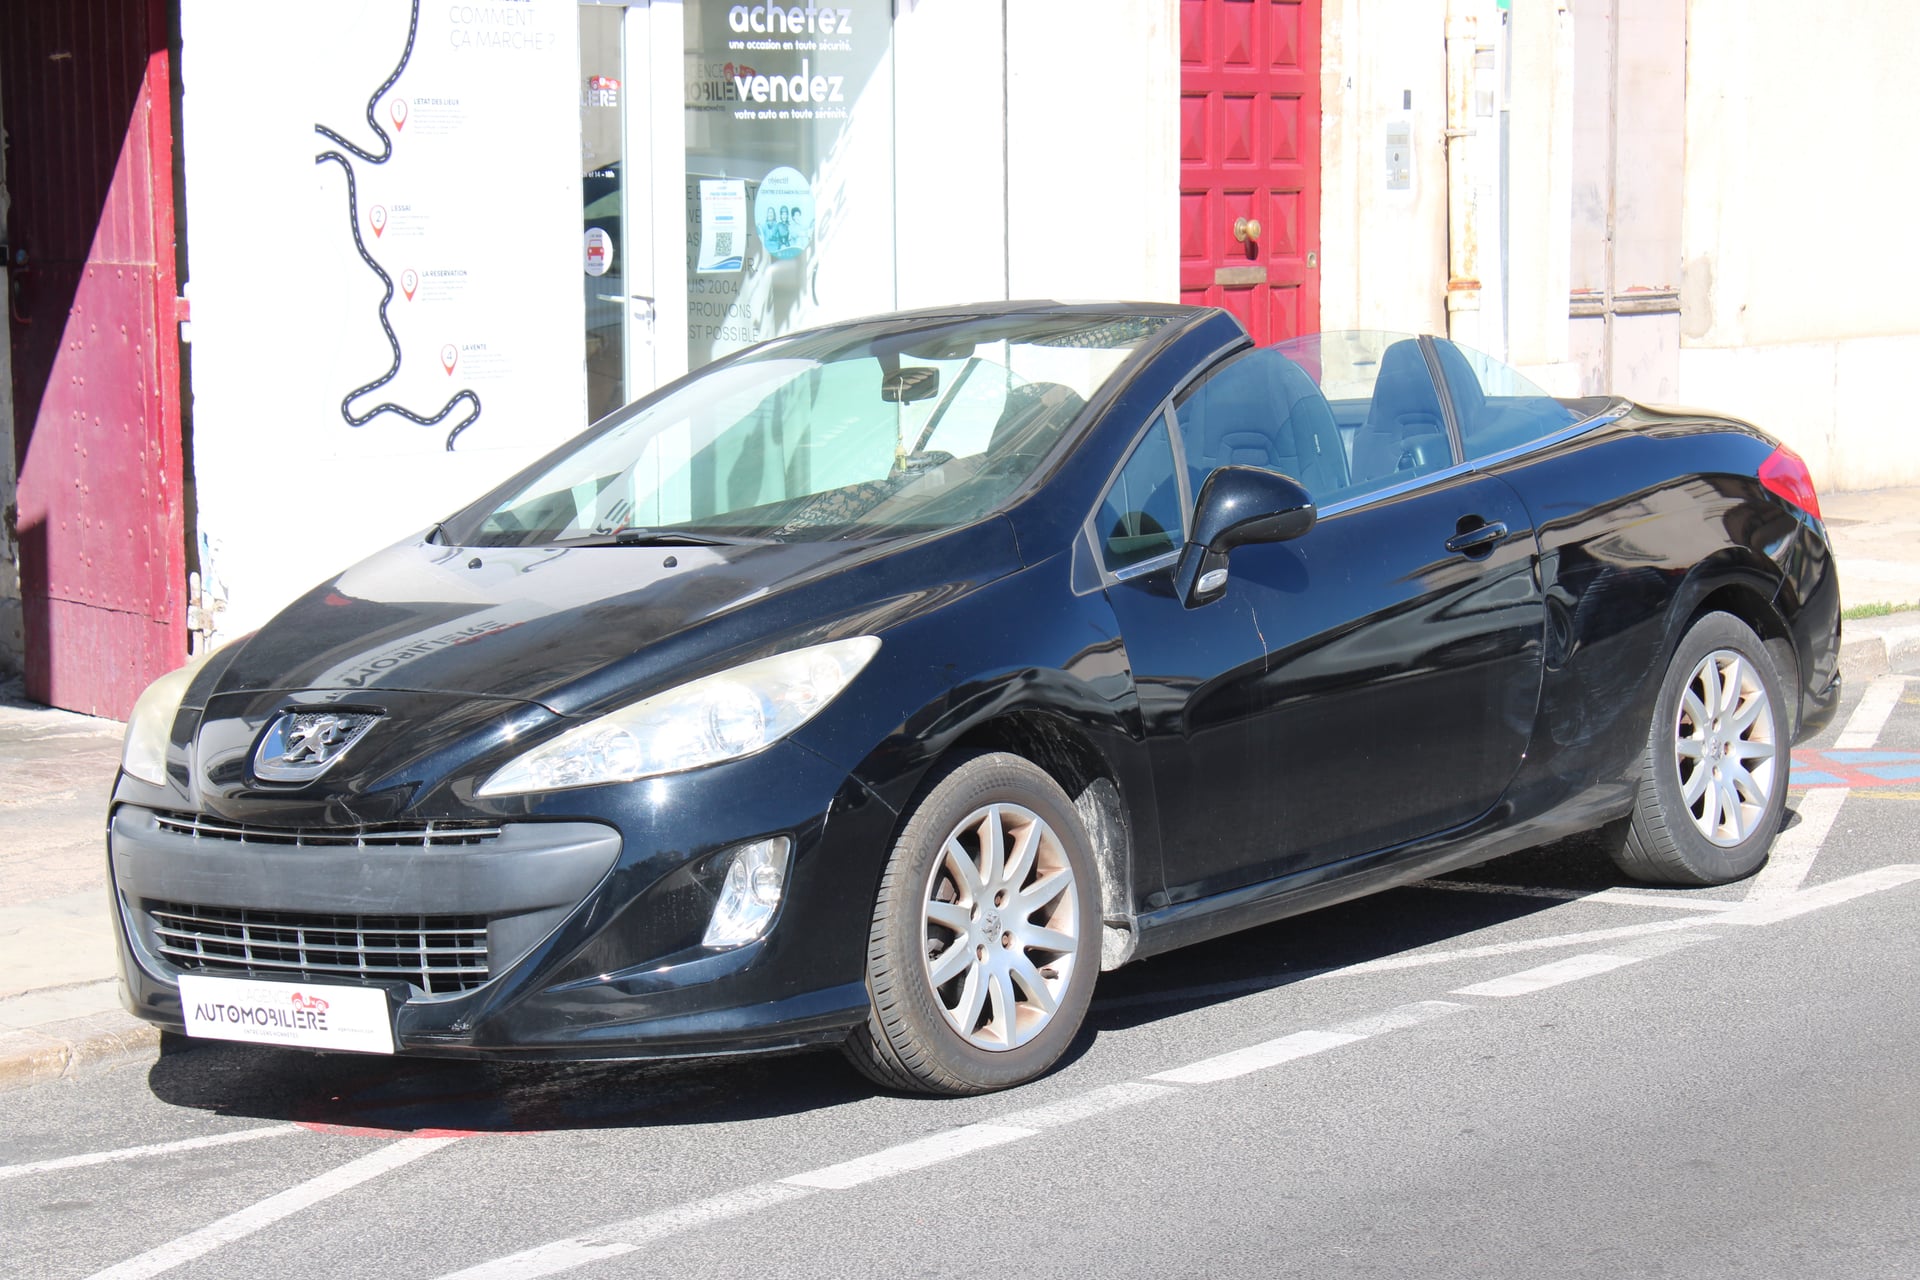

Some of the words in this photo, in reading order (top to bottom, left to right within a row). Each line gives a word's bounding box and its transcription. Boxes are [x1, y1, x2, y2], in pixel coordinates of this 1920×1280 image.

[449, 5, 535, 26] COMMENT
[728, 0, 853, 34] achetez
[450, 29, 471, 52] ÇA
[476, 31, 544, 50] MARCHE
[729, 40, 744, 50] une
[747, 38, 781, 50] occasion
[783, 41, 793, 50] en
[795, 40, 817, 51] toute
[734, 58, 844, 103] vendez
[734, 109, 756, 120] votre
[758, 109, 777, 120] auto
[779, 111, 790, 120] en
[791, 109, 813, 120] toute
[375, 210, 382, 223] 2
[406, 274, 413, 287] 3
[690, 301, 752, 319] PROUVONS
[706, 325, 759, 343] POSSIBLE
[446, 351, 453, 361] 4
